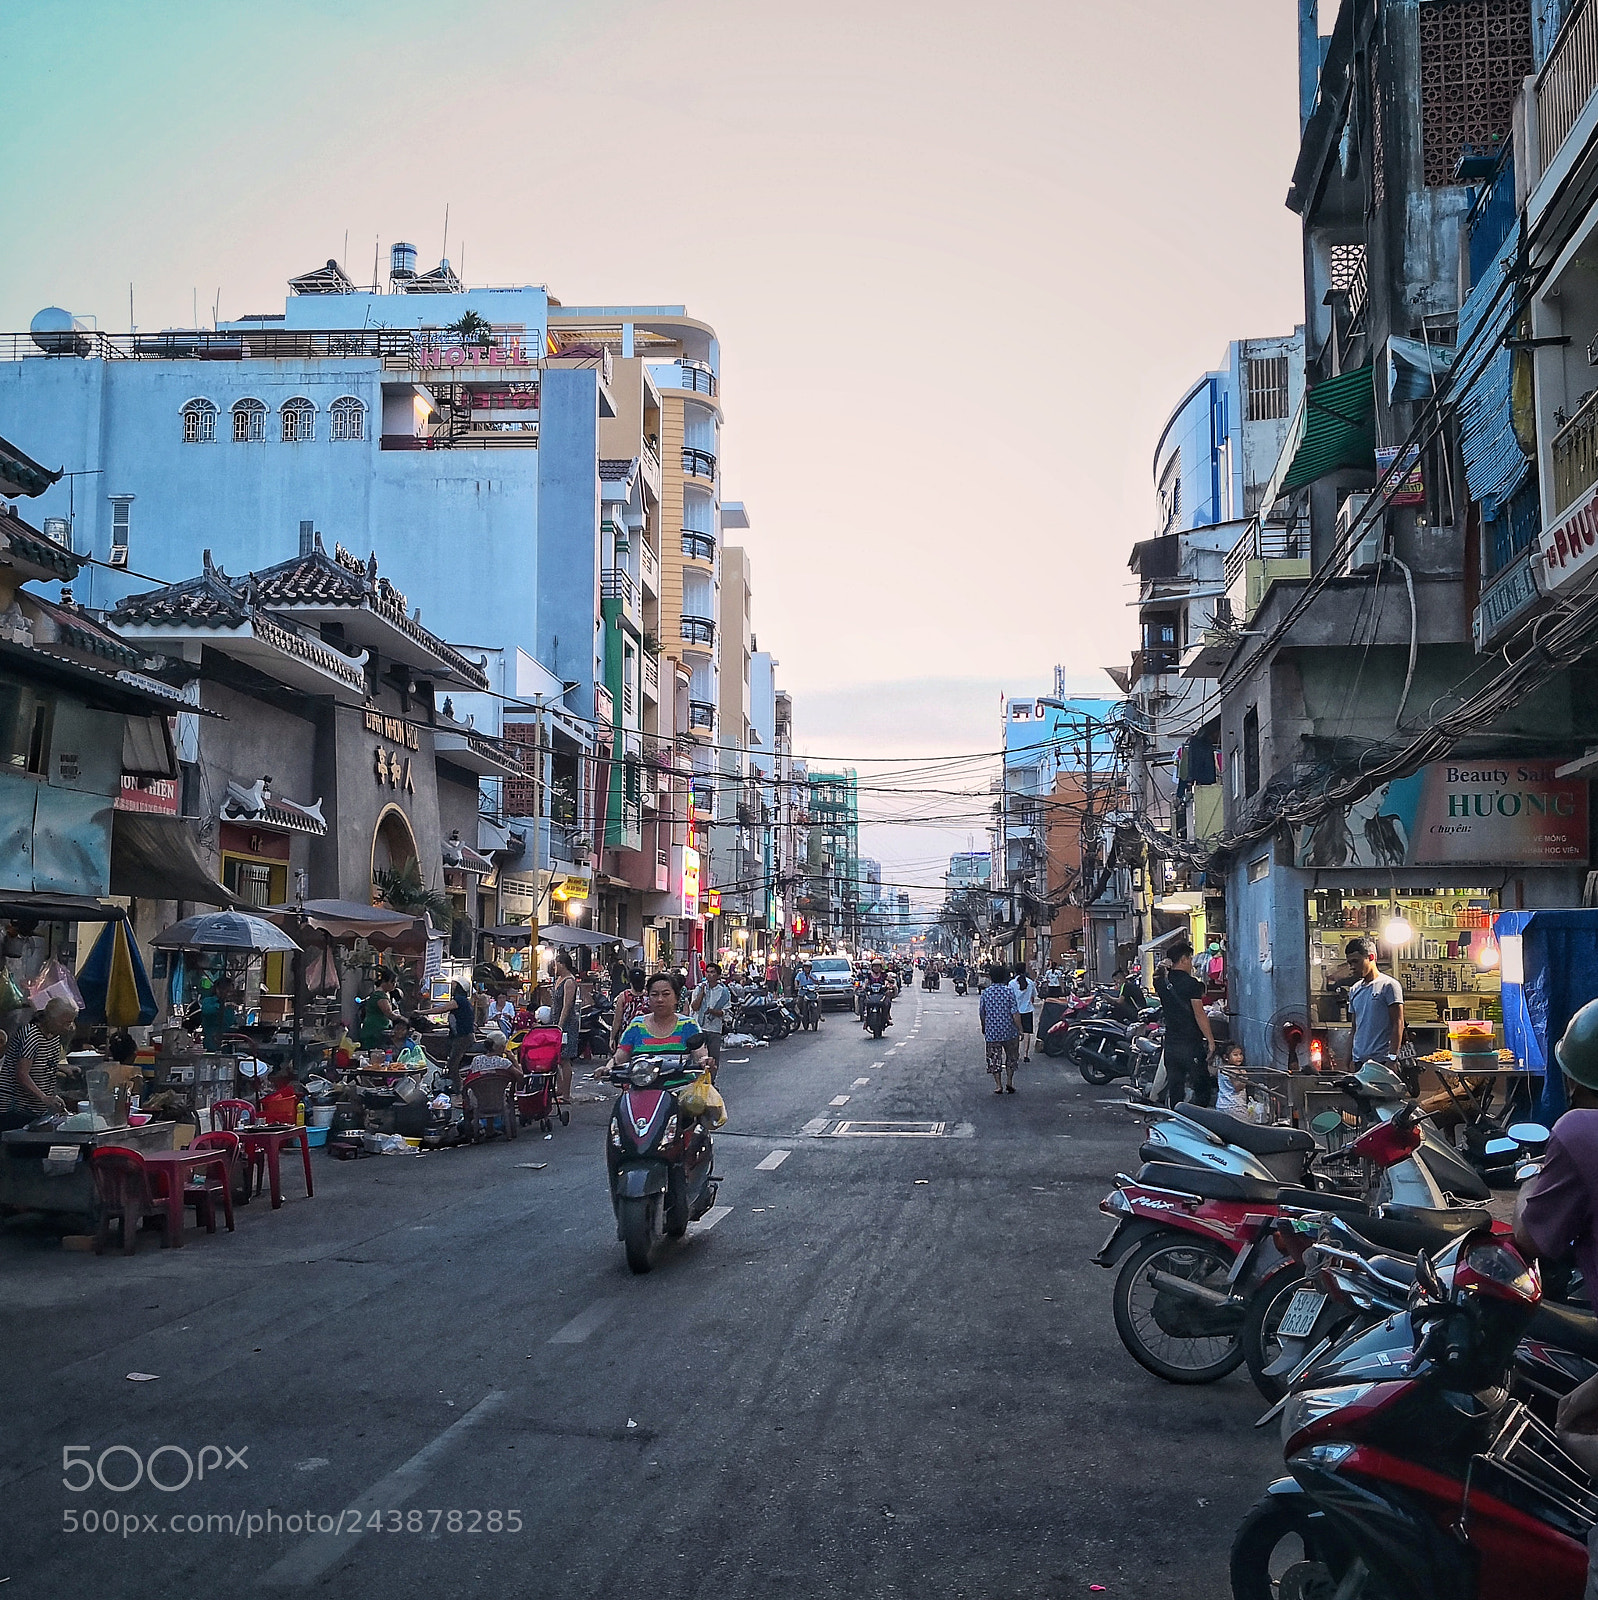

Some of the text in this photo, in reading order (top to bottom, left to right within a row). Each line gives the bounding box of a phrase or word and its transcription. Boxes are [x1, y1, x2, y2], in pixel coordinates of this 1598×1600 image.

[420, 346, 529, 367] HOTEL
[1446, 767, 1509, 785] Beauty
[1447, 790, 1575, 818] HƯƠNG
